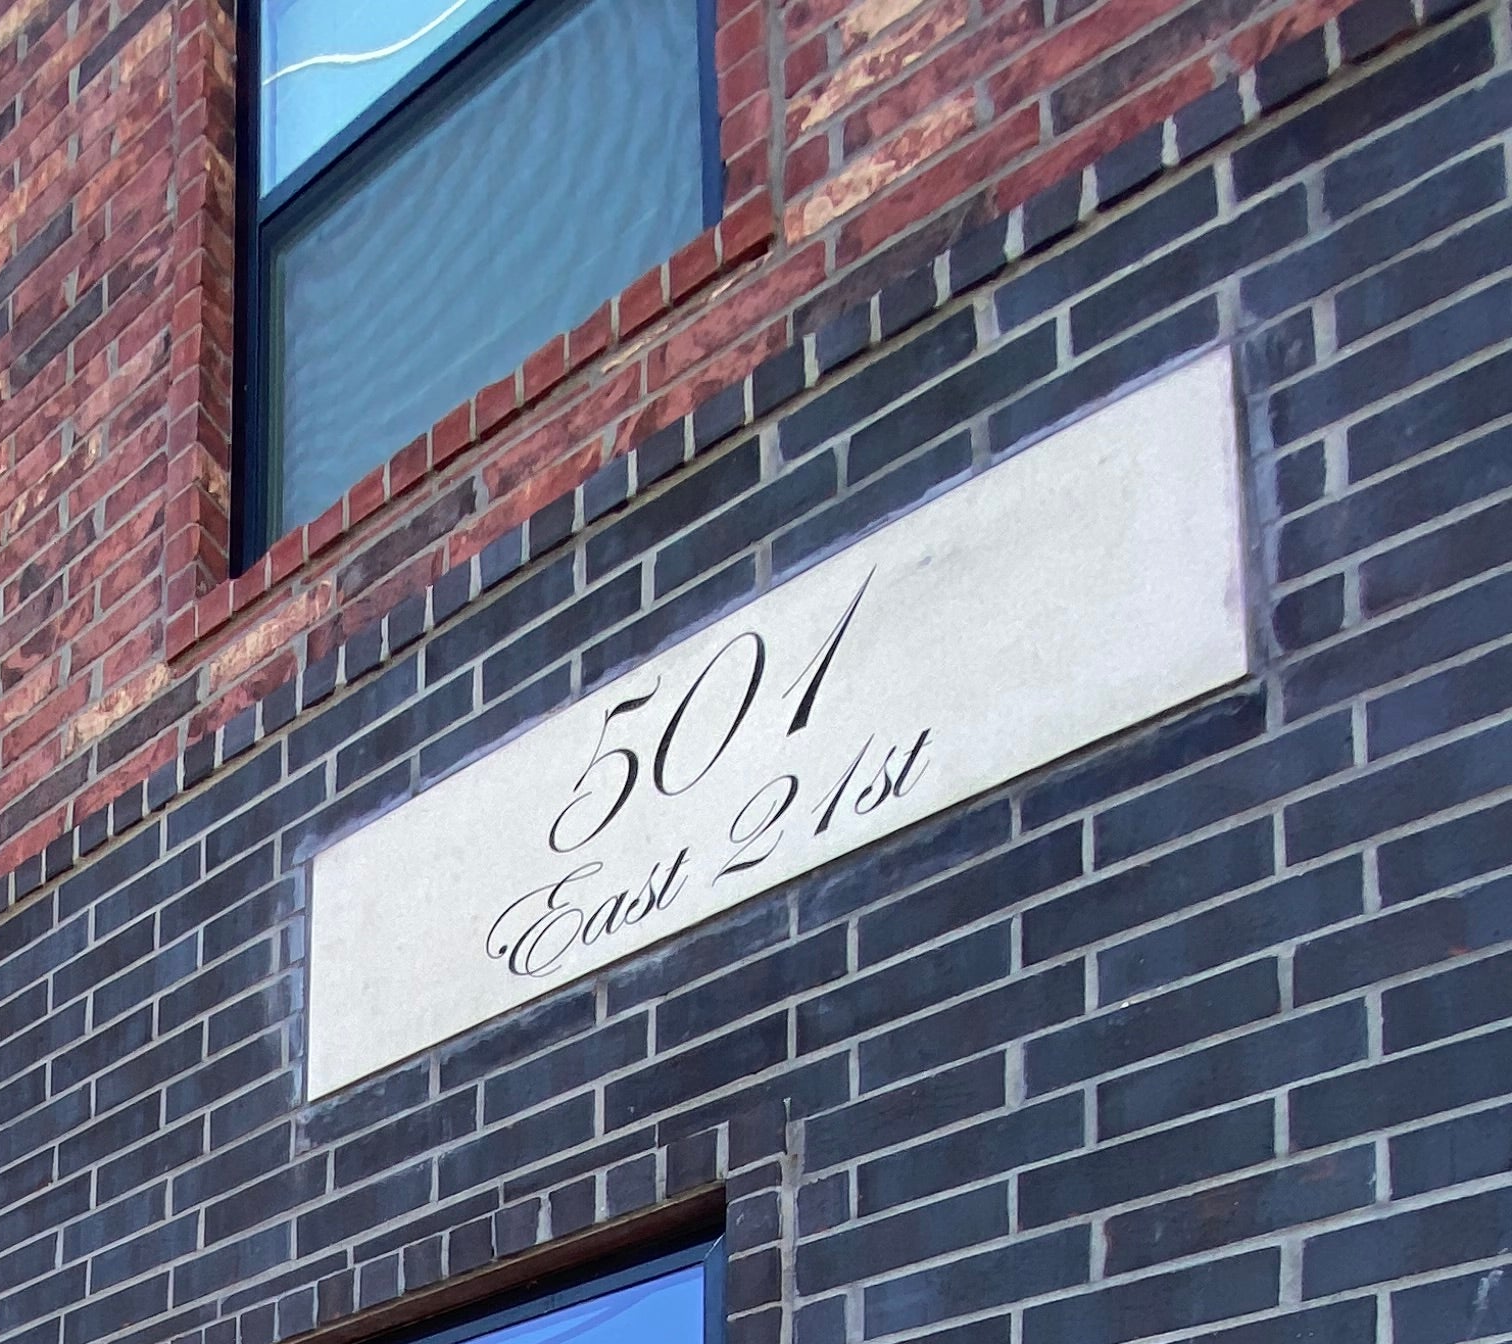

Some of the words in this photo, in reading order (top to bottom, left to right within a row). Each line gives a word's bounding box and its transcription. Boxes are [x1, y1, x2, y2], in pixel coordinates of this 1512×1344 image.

[548, 564, 876, 854] 501
[486, 848, 691, 978] East
[715, 728, 931, 881] 21st
